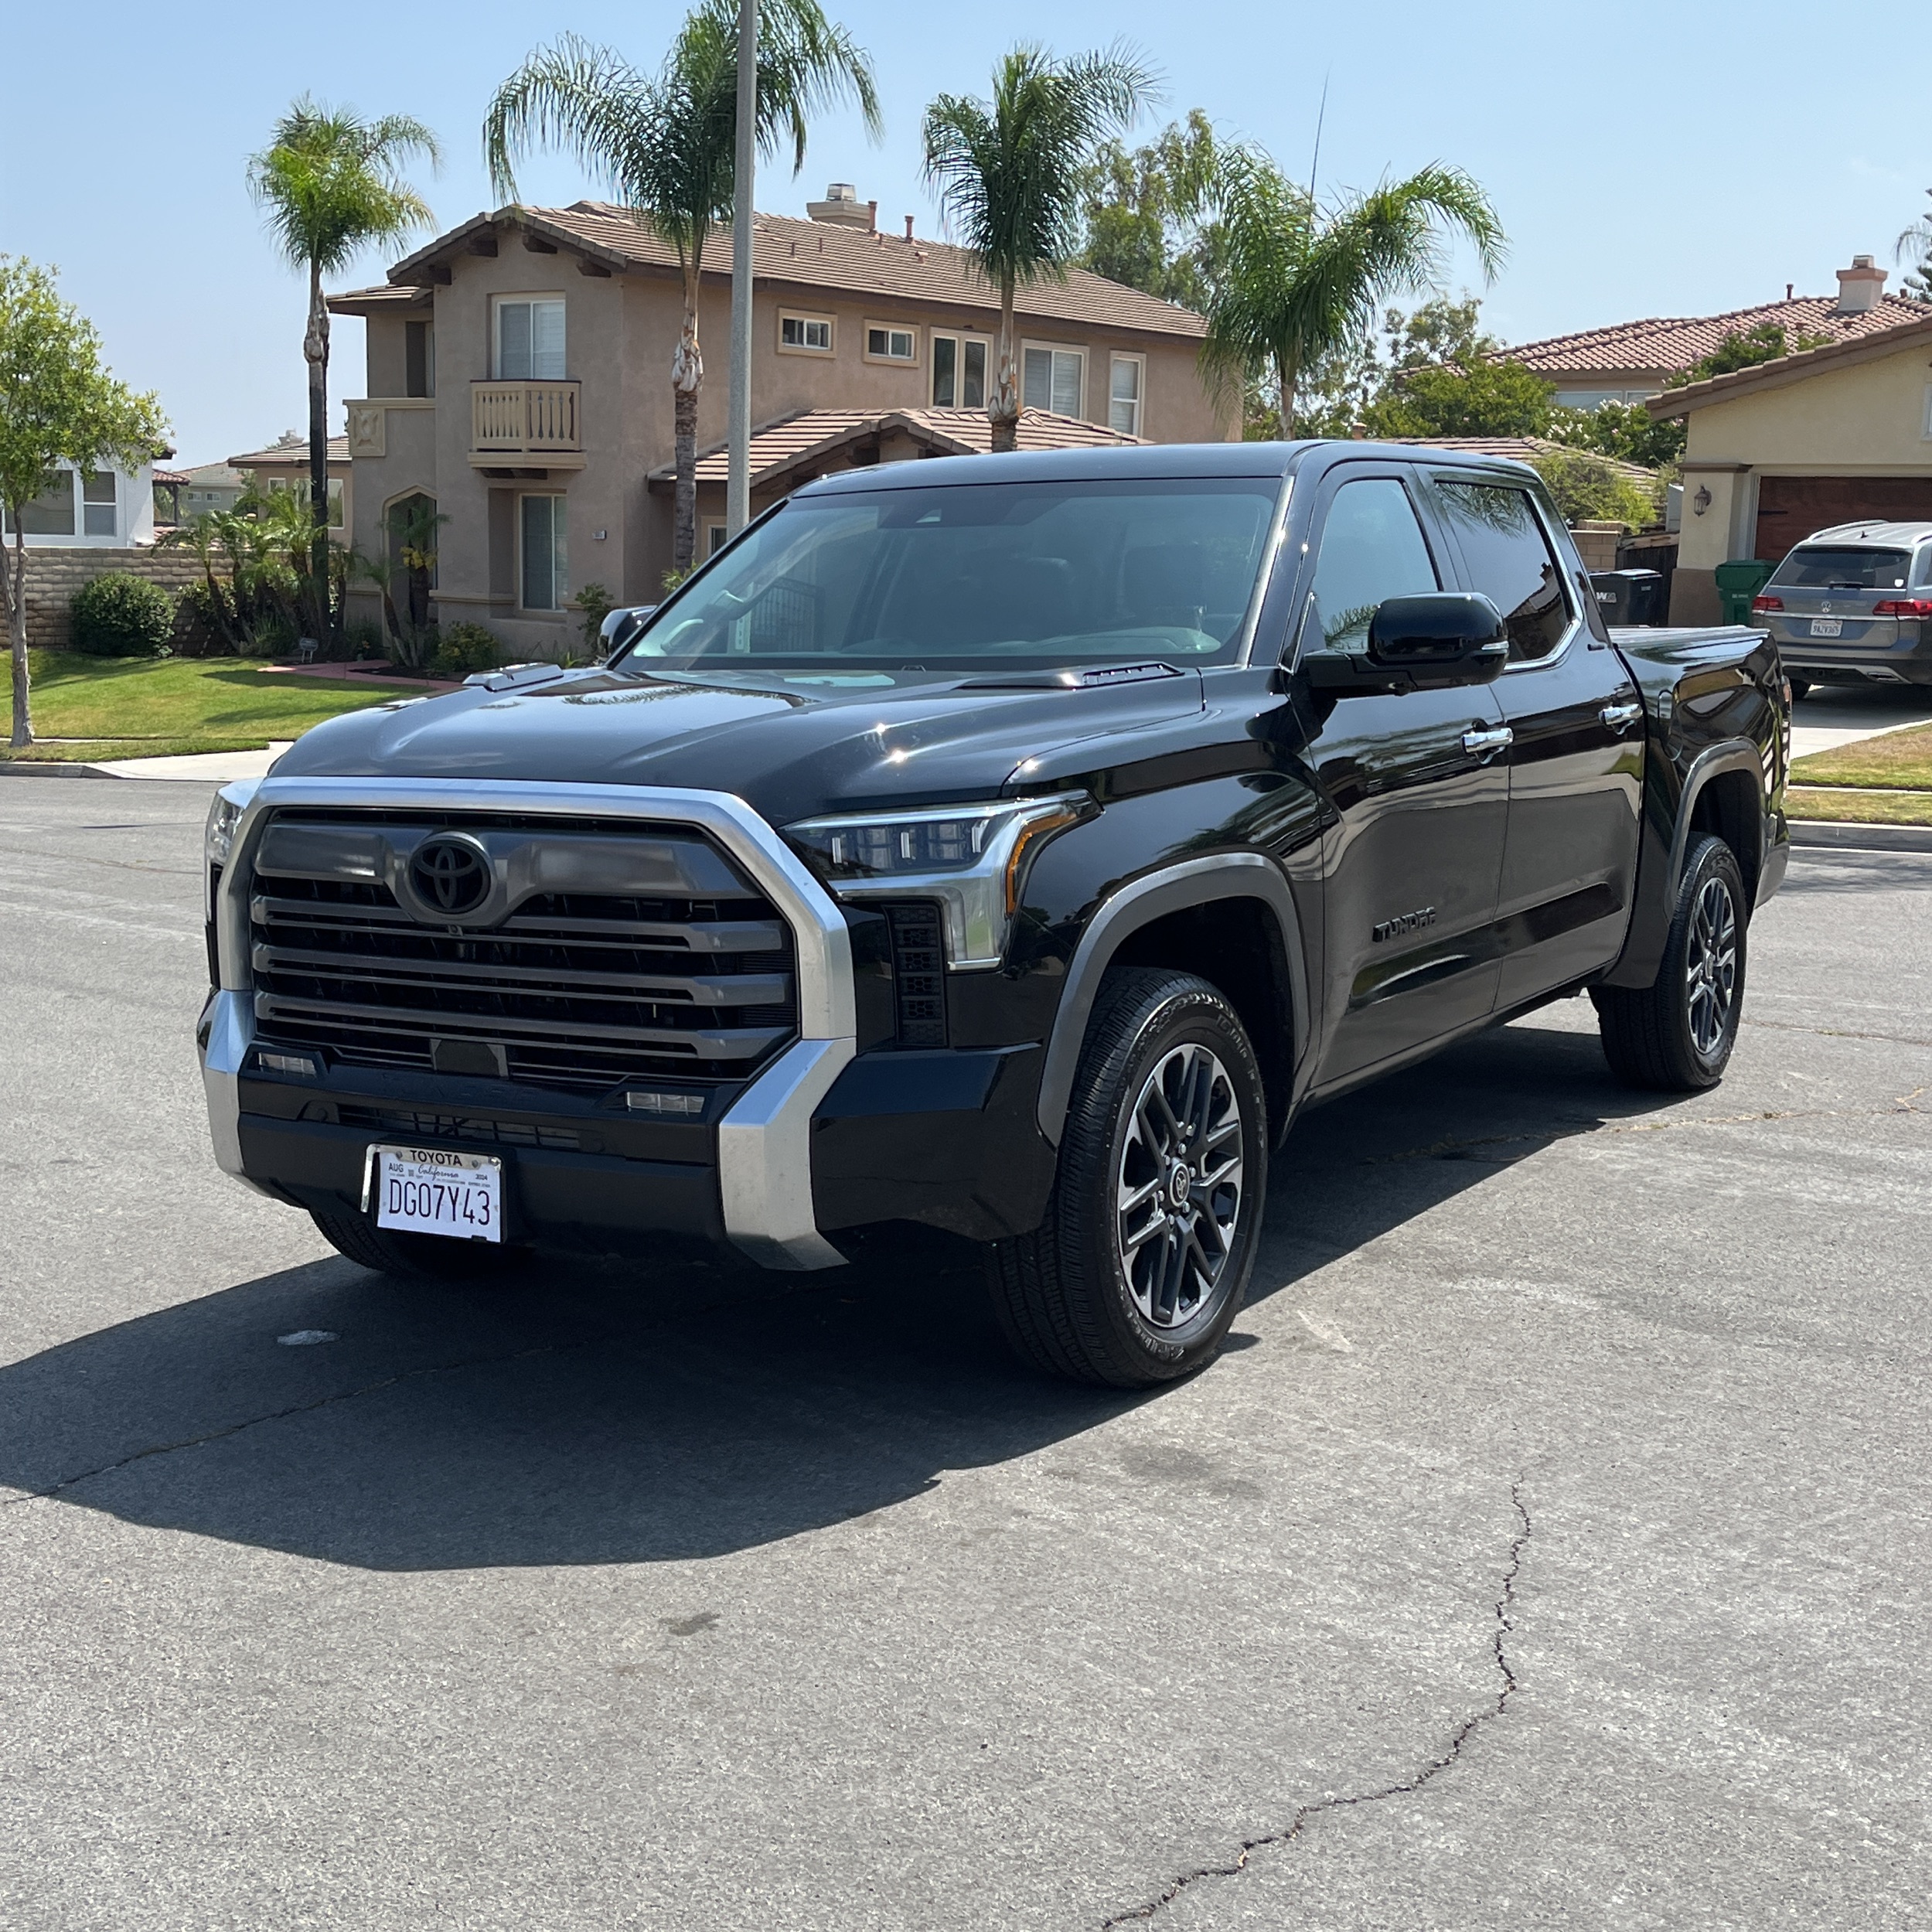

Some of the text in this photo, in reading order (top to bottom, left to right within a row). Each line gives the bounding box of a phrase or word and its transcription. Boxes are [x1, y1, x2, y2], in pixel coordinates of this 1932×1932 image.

[410, 1150, 462, 1167] TOYOTA
[388, 1163, 404, 1173] AUG
[418, 1164, 459, 1181] California
[389, 1178, 490, 1225] DG07Y43
